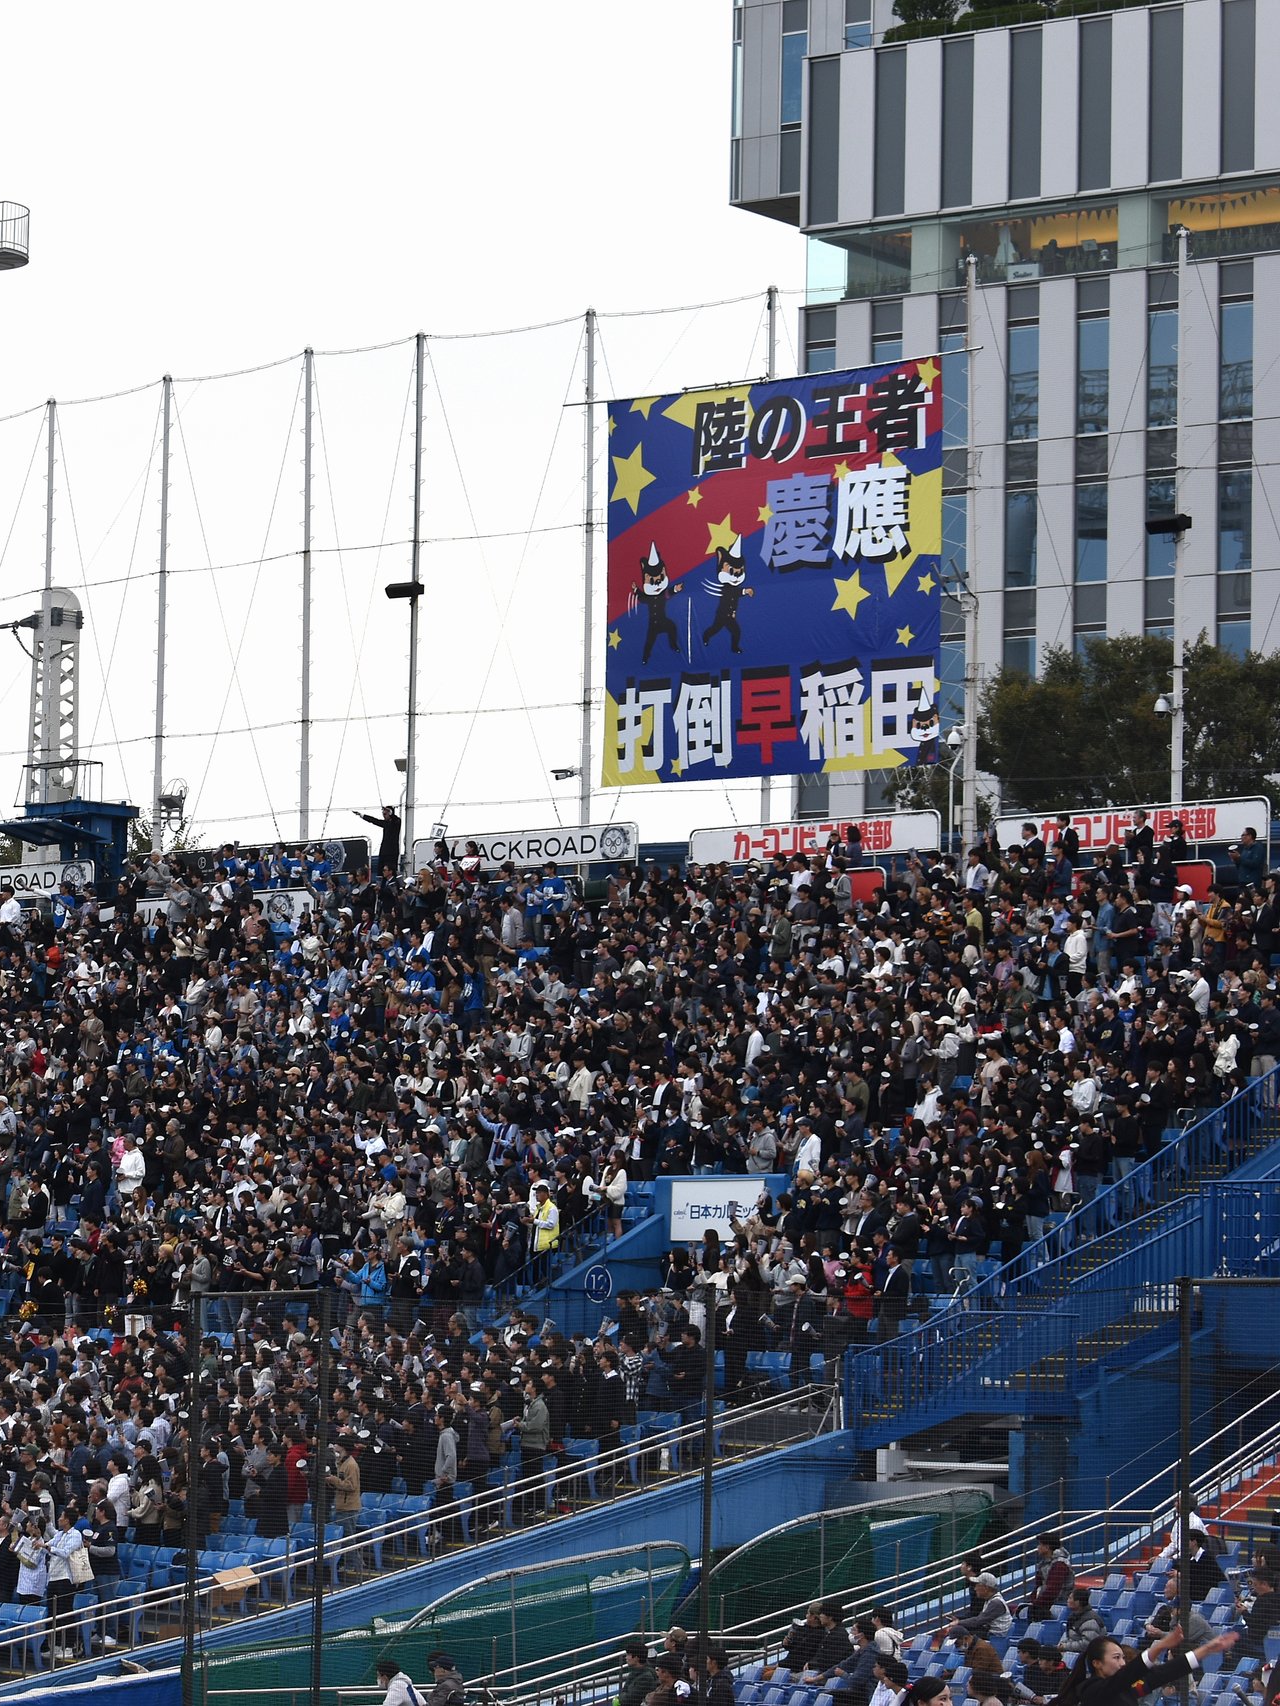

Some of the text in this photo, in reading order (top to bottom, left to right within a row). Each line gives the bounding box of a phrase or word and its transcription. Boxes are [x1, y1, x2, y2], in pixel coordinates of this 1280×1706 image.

[692, 374, 934, 477] 陸の王者
[760, 464, 912, 573] 慶應
[616, 656, 936, 774] 打倒早稲田
[474, 835, 597, 862] ACKROAD
[1041, 807, 1217, 849] カコンビ倶楽部
[591, 1274, 607, 1294] 12
